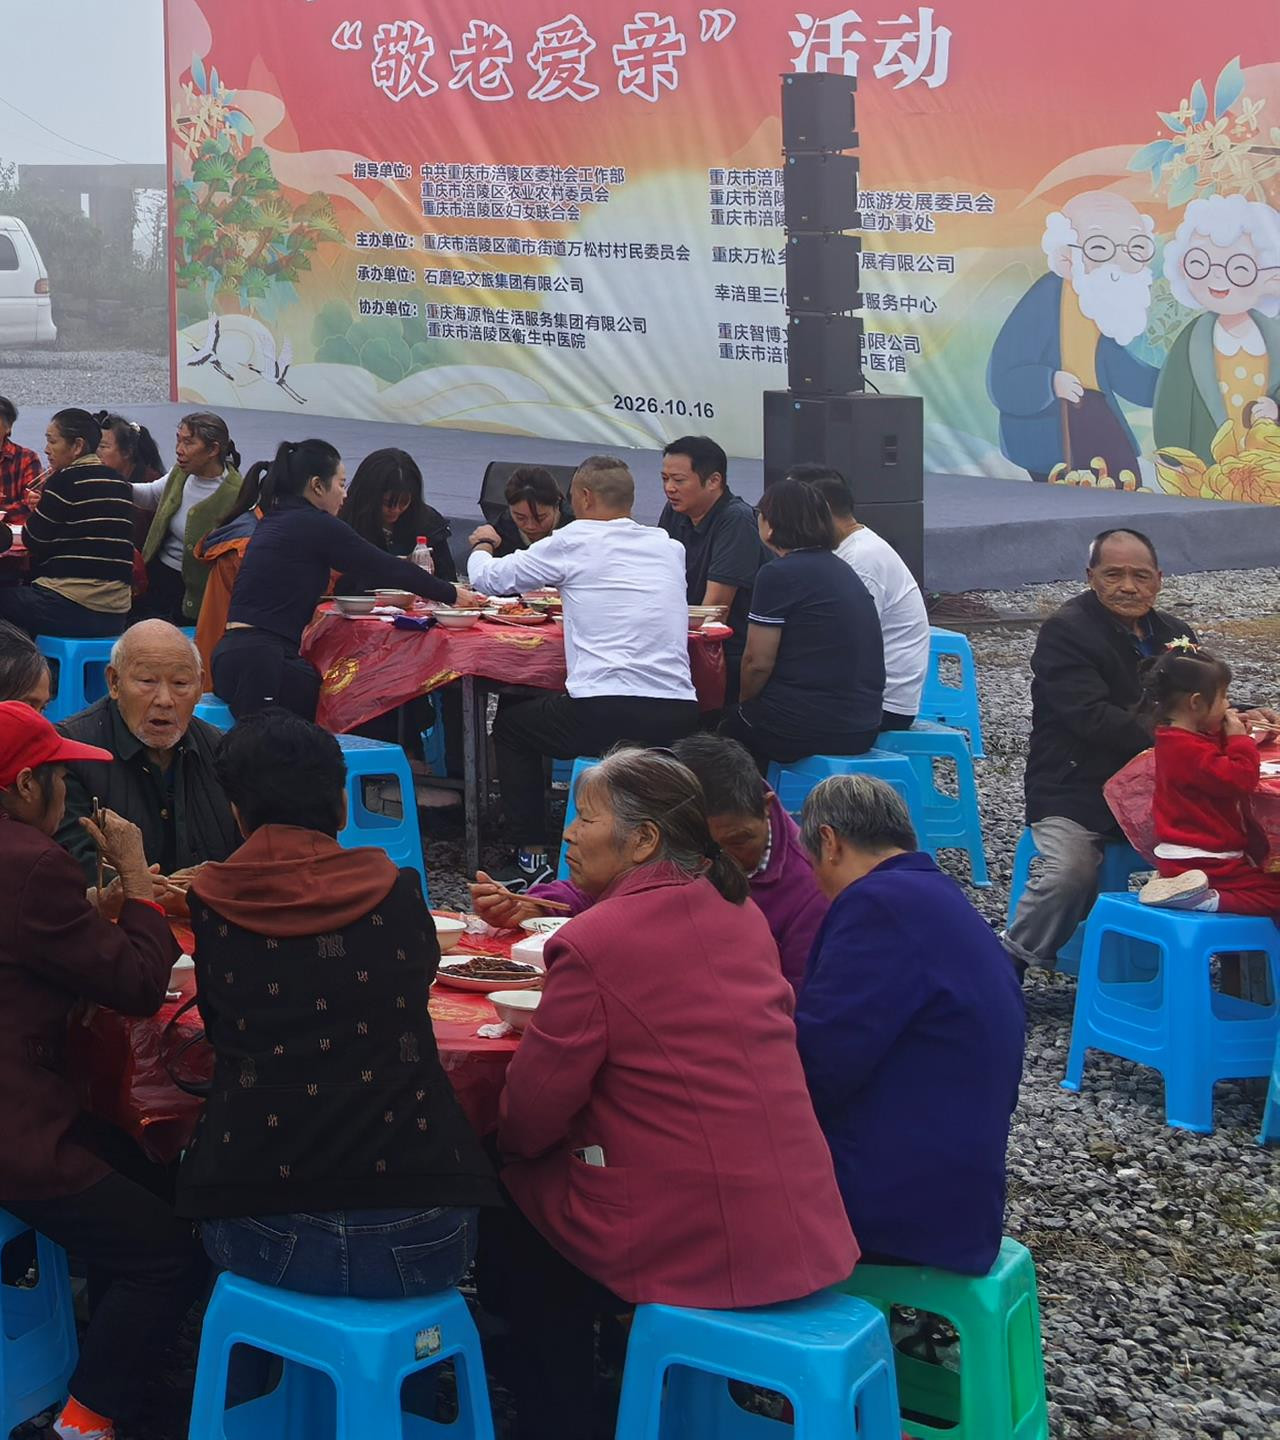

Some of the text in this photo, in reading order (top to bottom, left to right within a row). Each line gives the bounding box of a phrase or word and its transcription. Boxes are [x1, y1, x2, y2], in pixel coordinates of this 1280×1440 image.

[788, 7, 952, 90] 活动
[421, 165, 625, 184] 中共重庆市涪陵区委社会工作部
[422, 182, 609, 203] 重庆市涪陵区农业农村委员会
[423, 201, 580, 221] 重庆市涪陵区妇女联合会
[424, 235, 690, 261] 重庆市涪陵区蔺市街道万松村村民委员会
[425, 268, 584, 293] 石磨纪文旅集团有限公司
[613, 394, 714, 418] 2026.10.16
